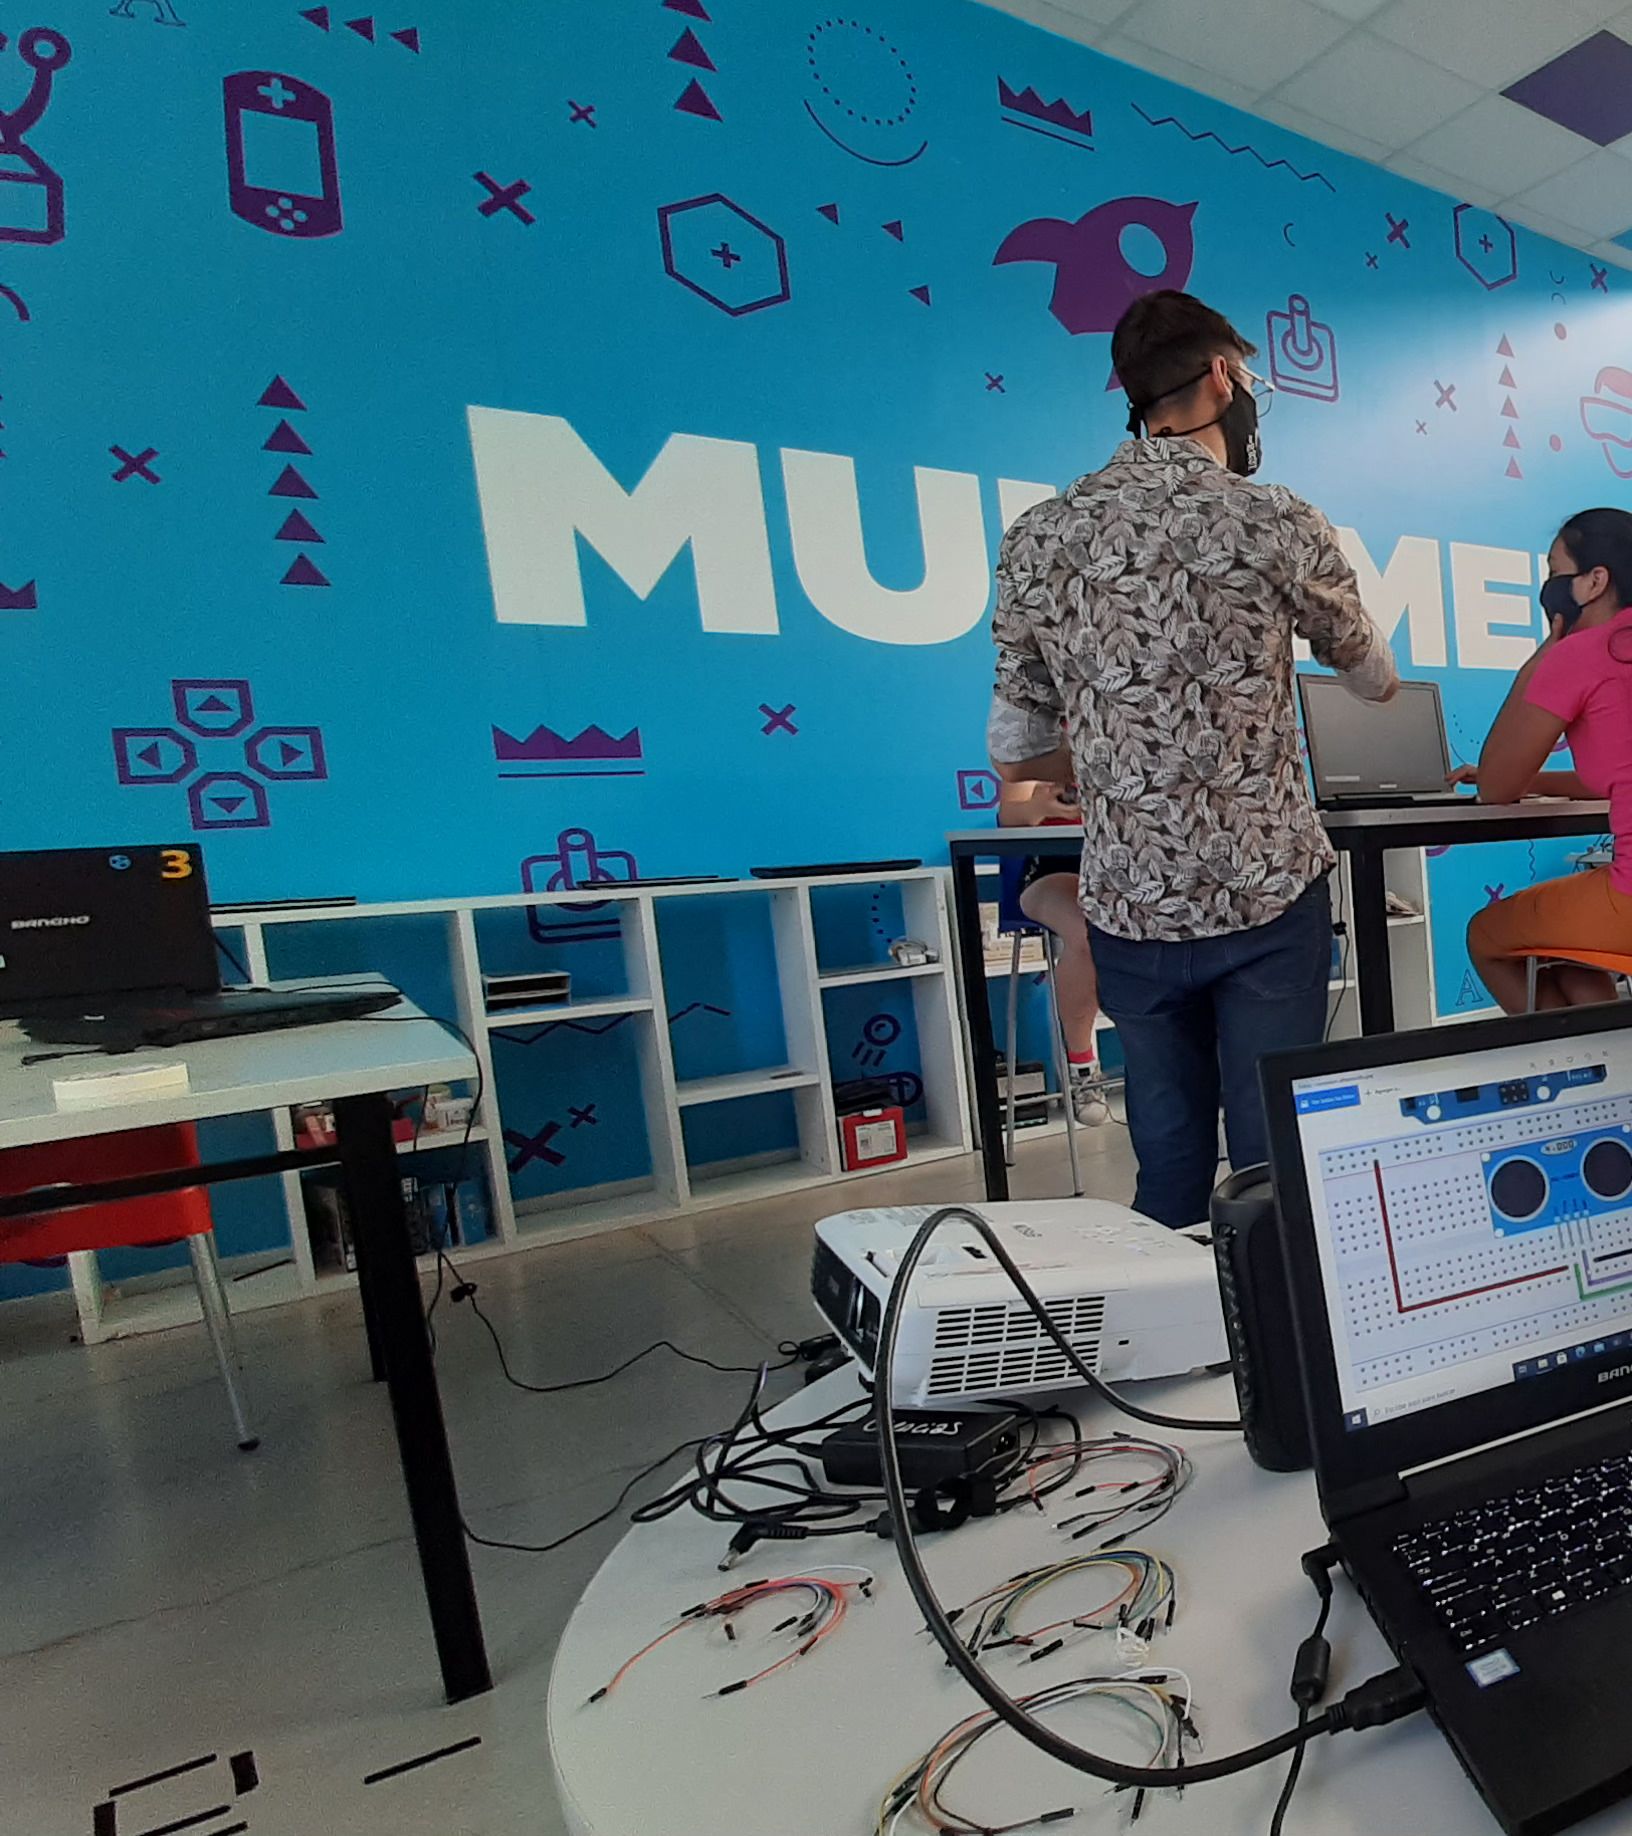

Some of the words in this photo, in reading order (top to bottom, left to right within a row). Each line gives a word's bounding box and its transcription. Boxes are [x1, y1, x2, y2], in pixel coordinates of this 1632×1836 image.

[160, 849, 193, 880] 3
[11, 915, 90, 930] BANGHO
[1455, 968, 1484, 1007] A
